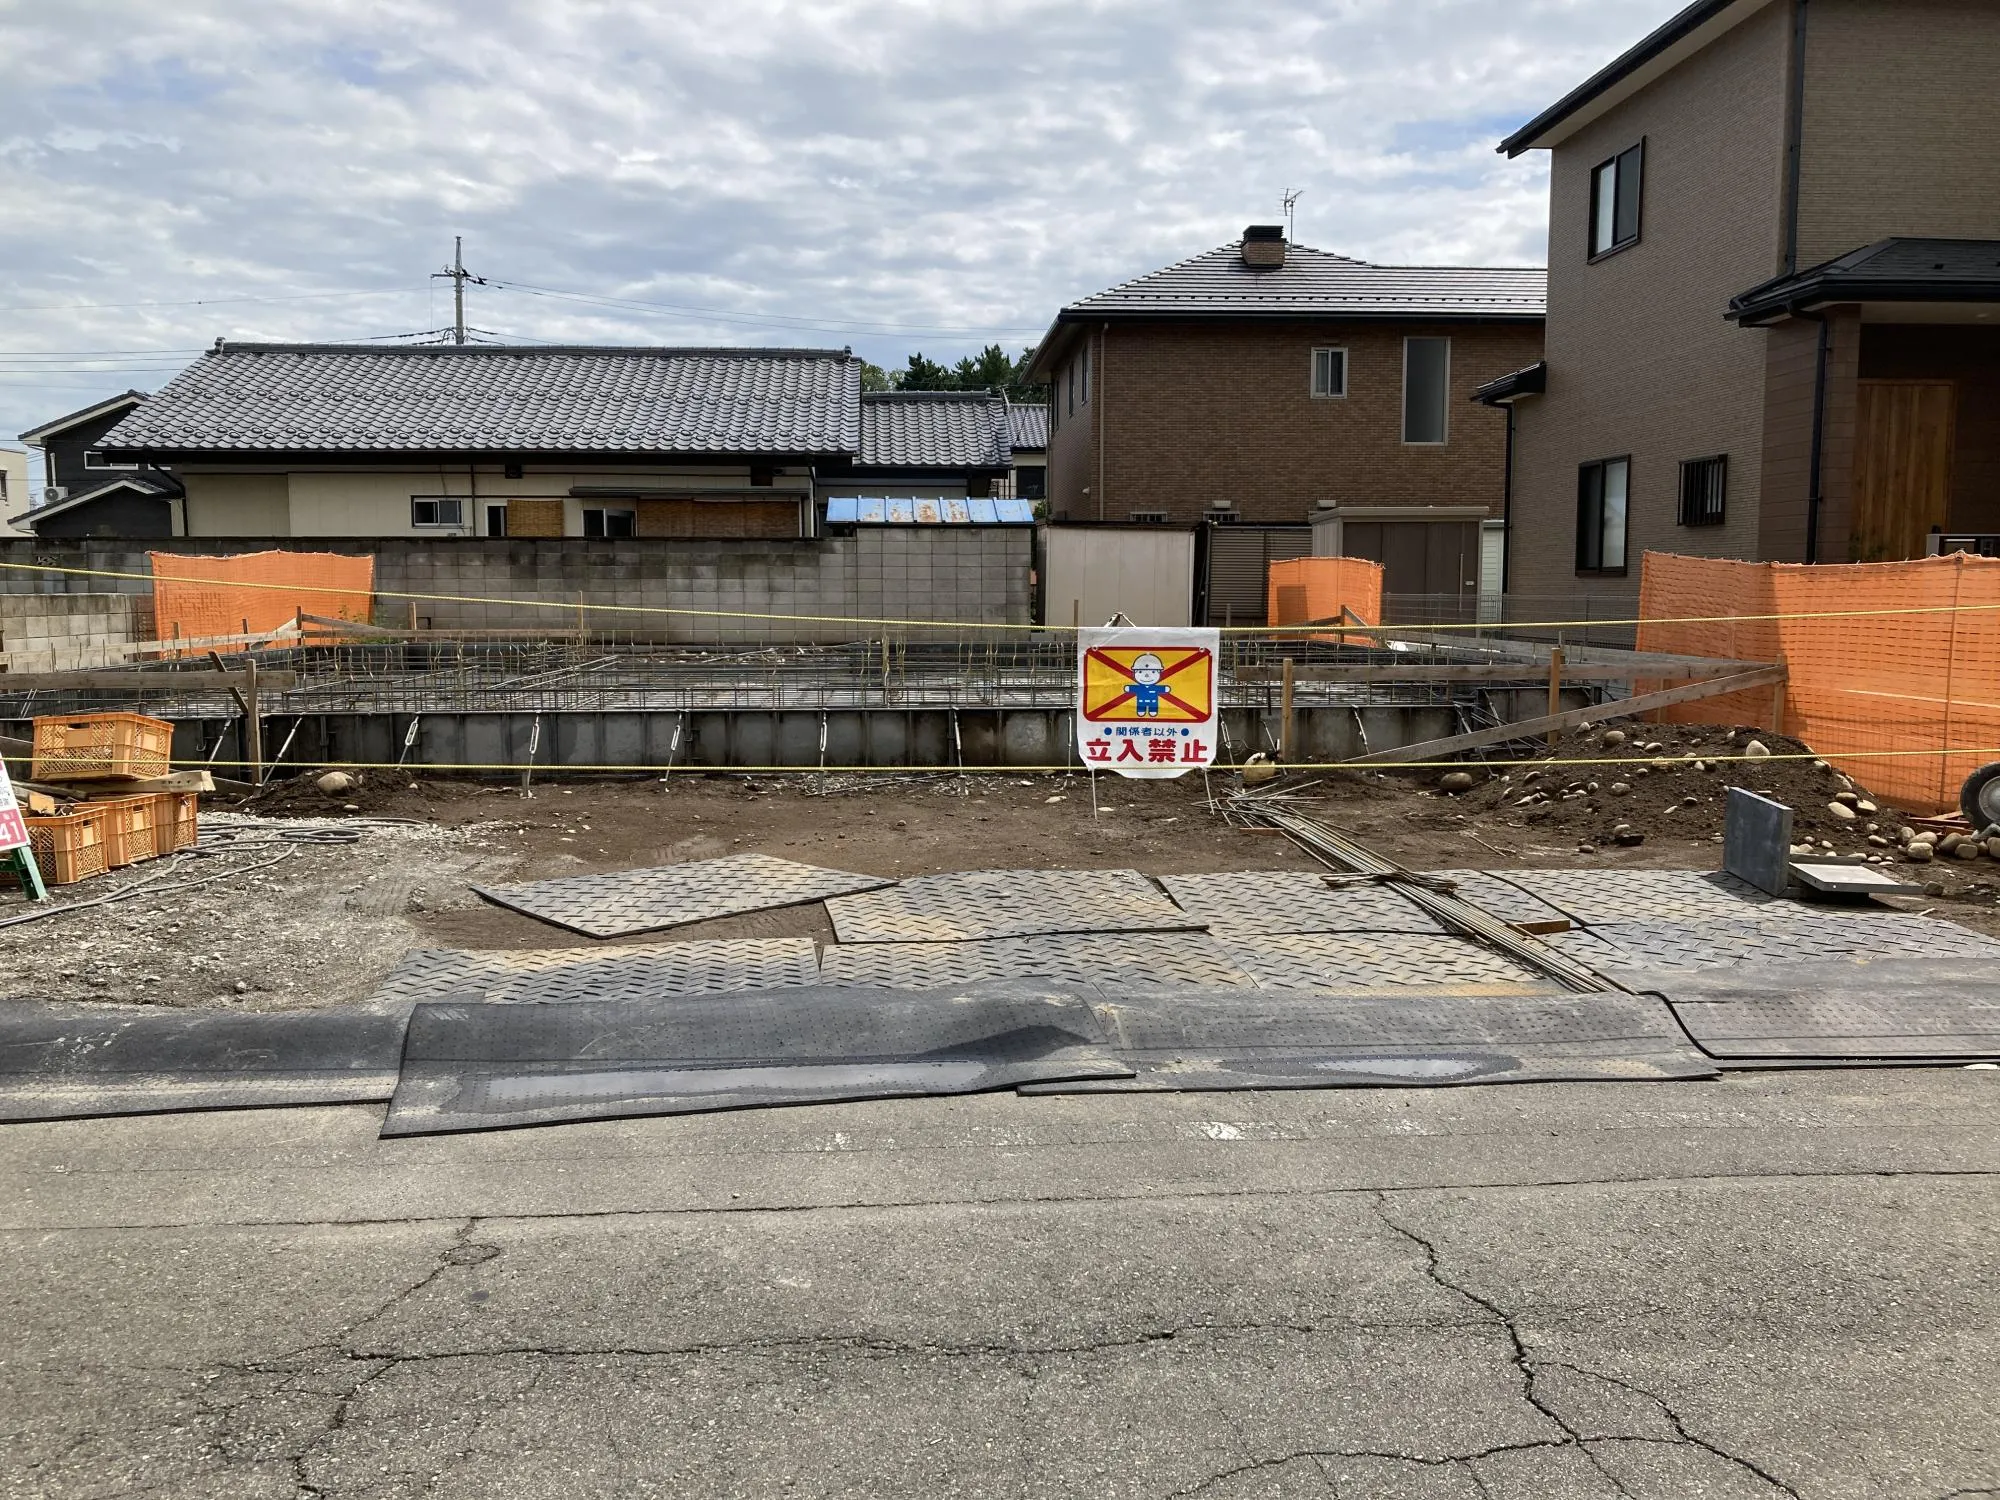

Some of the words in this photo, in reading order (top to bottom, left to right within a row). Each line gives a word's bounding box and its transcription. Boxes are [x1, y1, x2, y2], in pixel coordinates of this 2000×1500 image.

[1115, 726, 1178, 737] 関係者以外
[1086, 738, 1208, 762] 立入禁止
